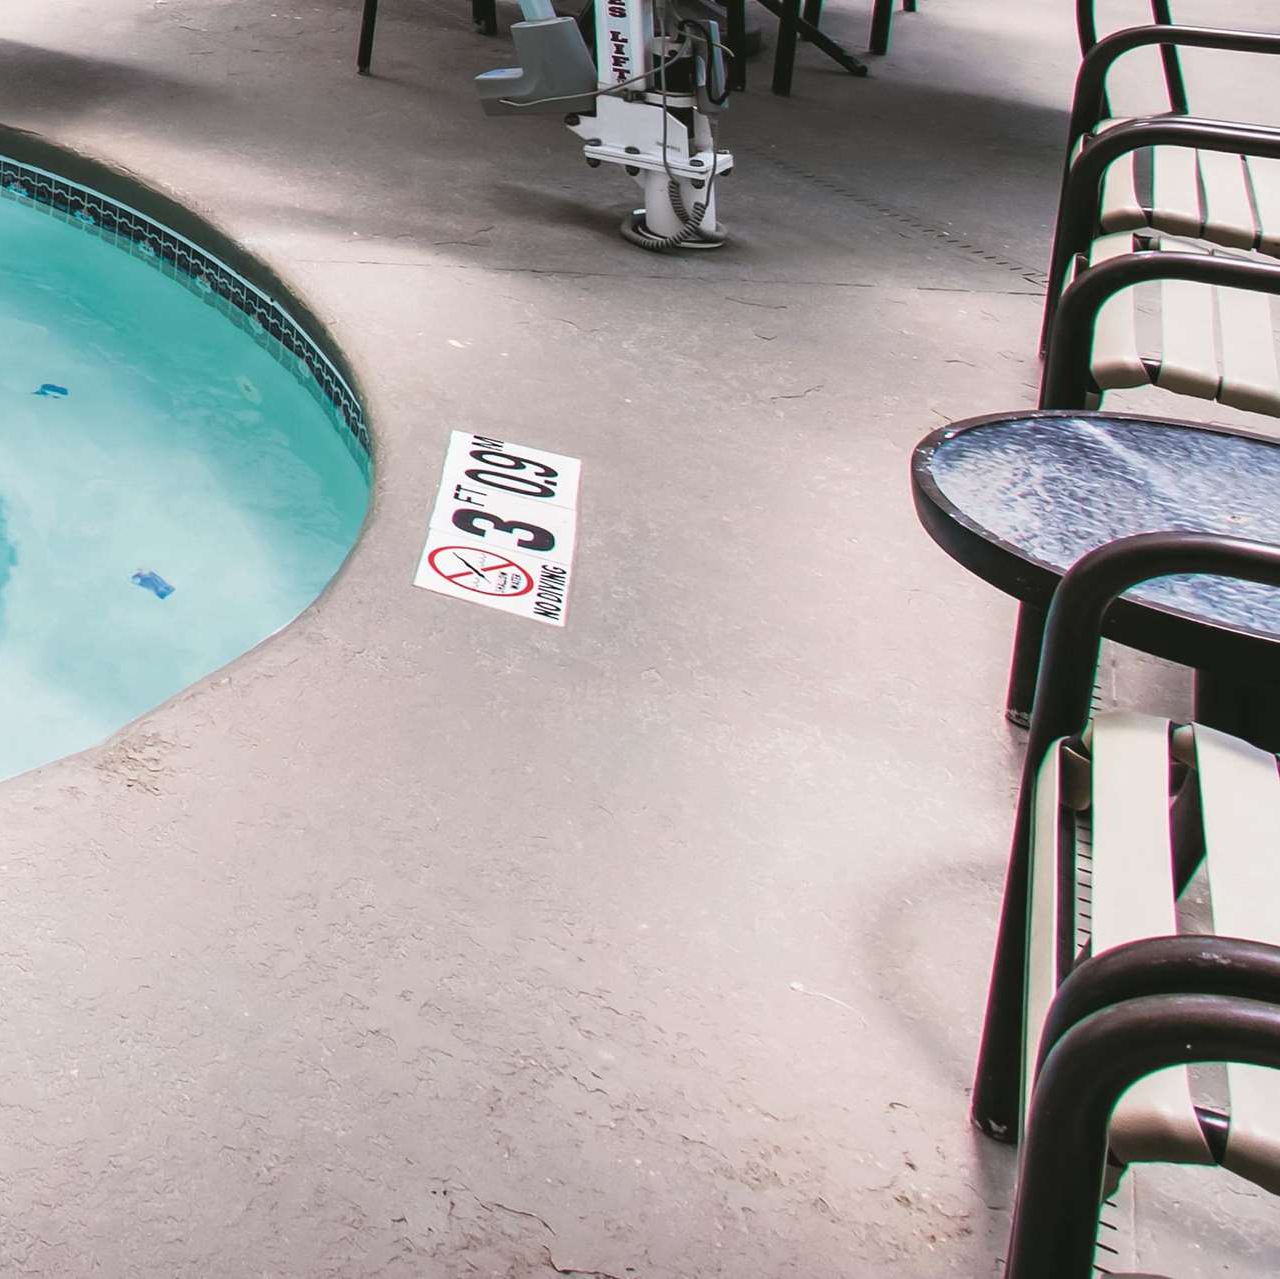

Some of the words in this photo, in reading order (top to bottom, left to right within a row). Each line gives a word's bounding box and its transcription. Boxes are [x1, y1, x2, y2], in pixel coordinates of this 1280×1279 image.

[610, 30, 631, 81] LIFT
[471, 434, 505, 452] M
[464, 449, 559, 499] 0.9
[453, 484, 488, 507] FT
[451, 508, 556, 552] 3
[537, 565, 567, 603] DIVING
[533, 601, 562, 621] NO
